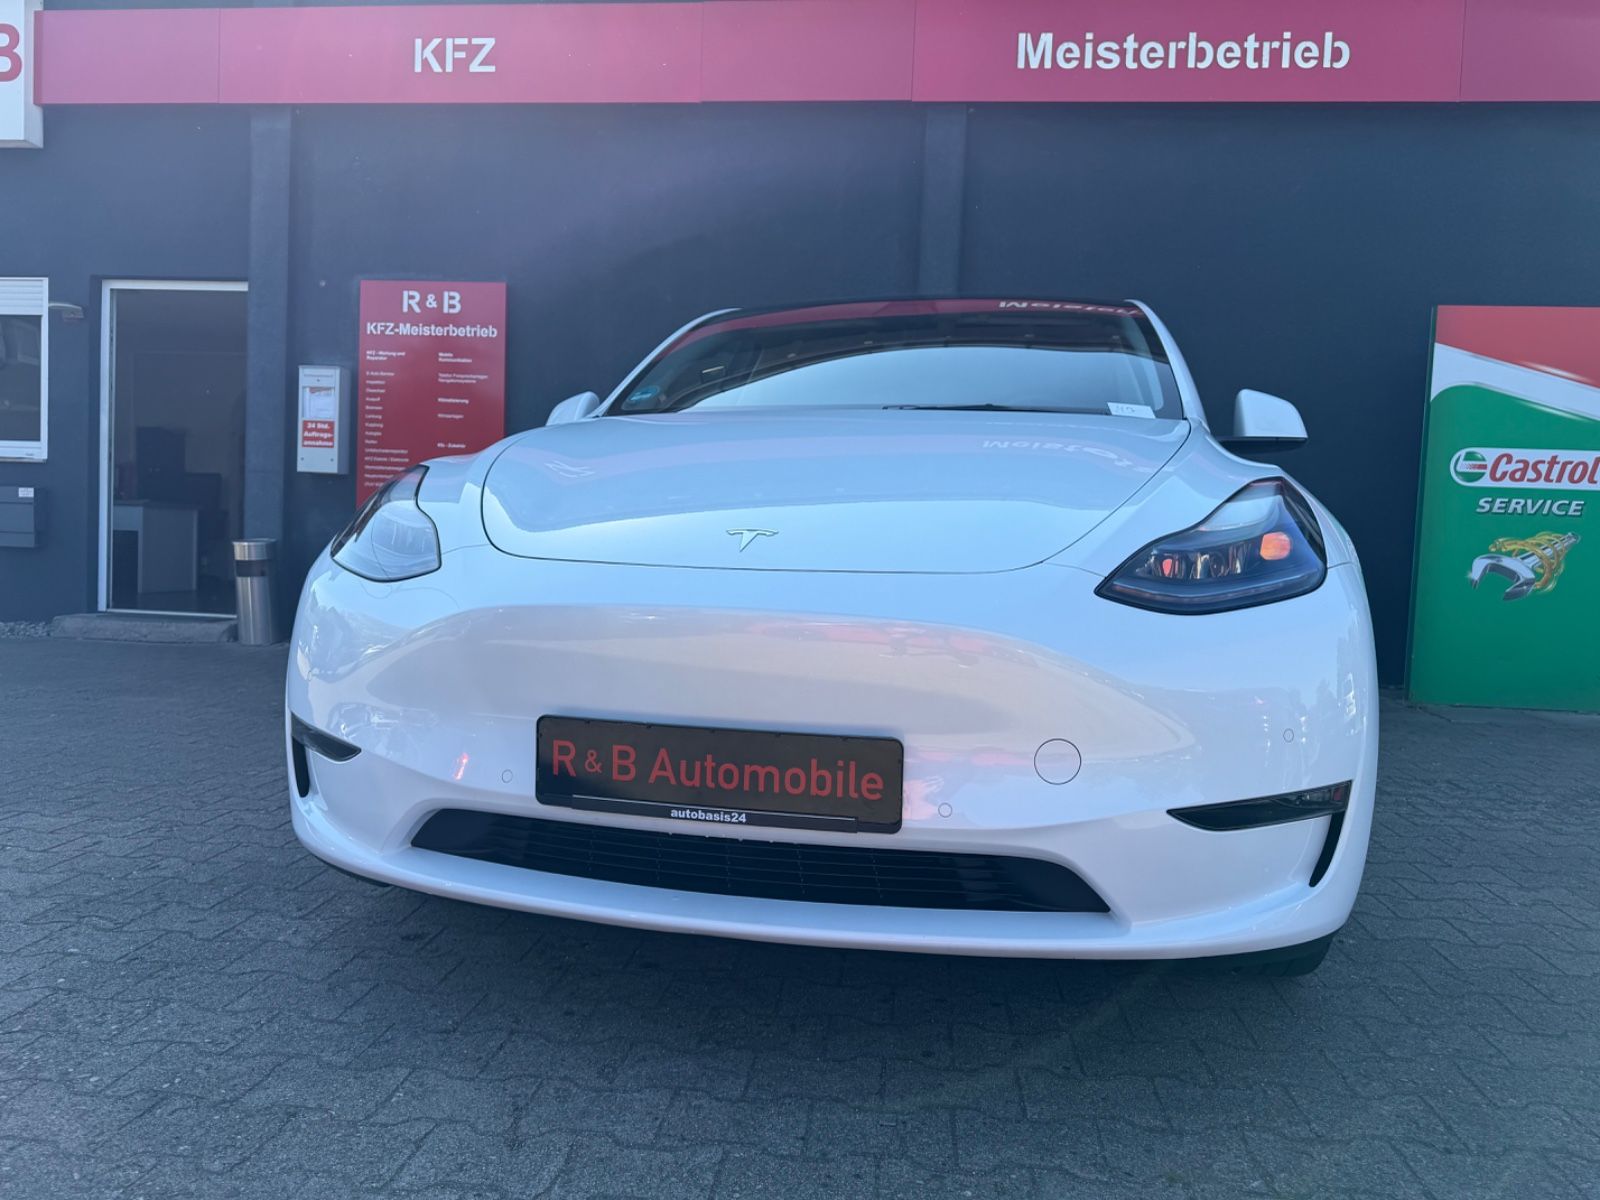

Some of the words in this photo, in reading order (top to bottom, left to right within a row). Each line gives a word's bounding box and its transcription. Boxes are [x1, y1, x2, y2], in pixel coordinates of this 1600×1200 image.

[414, 37, 496, 73] KFZ
[1016, 31, 1351, 70] Meisterbetrieb
[402, 290, 421, 313] R
[426, 294, 438, 308] &
[443, 291, 462, 314] B
[366, 322, 498, 338] KFZ-Meisterbetrieb
[1489, 453, 1600, 485] Castrol
[1476, 497, 1584, 517] SERVICE
[552, 739, 577, 777] R
[584, 750, 602, 774] &
[611, 744, 637, 782] B
[648, 747, 884, 801] Automobile
[670, 809, 747, 823] autobasis24
